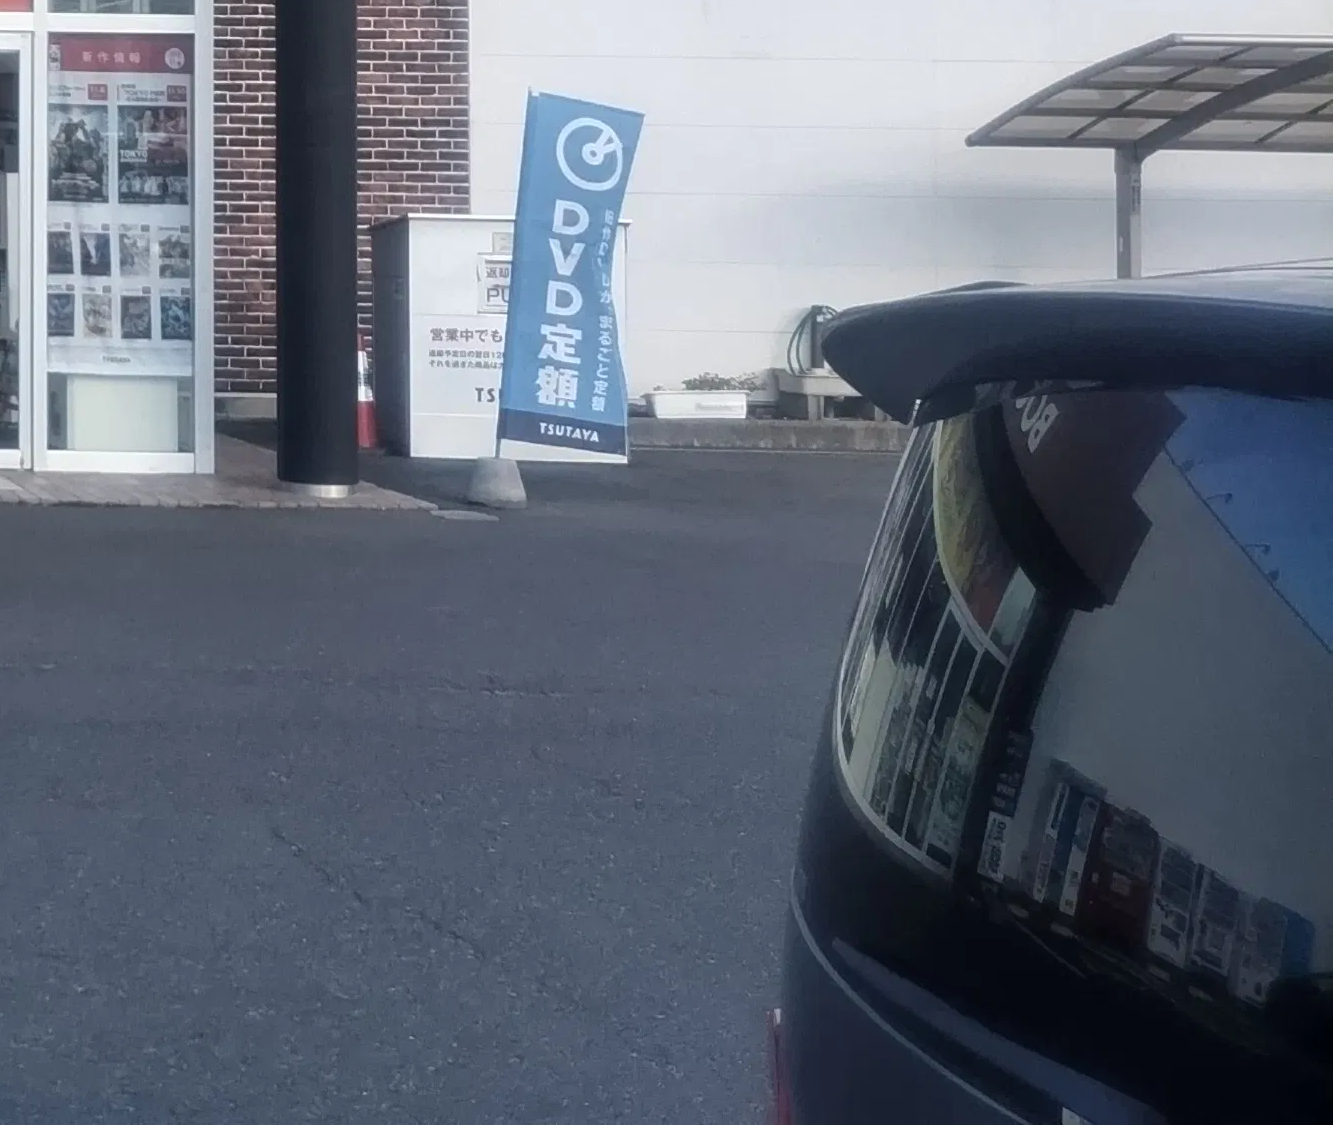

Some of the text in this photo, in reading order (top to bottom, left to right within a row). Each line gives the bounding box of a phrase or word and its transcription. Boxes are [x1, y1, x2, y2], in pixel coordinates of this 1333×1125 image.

[536, 198, 590, 409] DVD定額
[429, 327, 503, 342] 営業中でも
[428, 349, 504, 359] 返却予定日の翌日12
[538, 422, 600, 443] TSUTAYA
